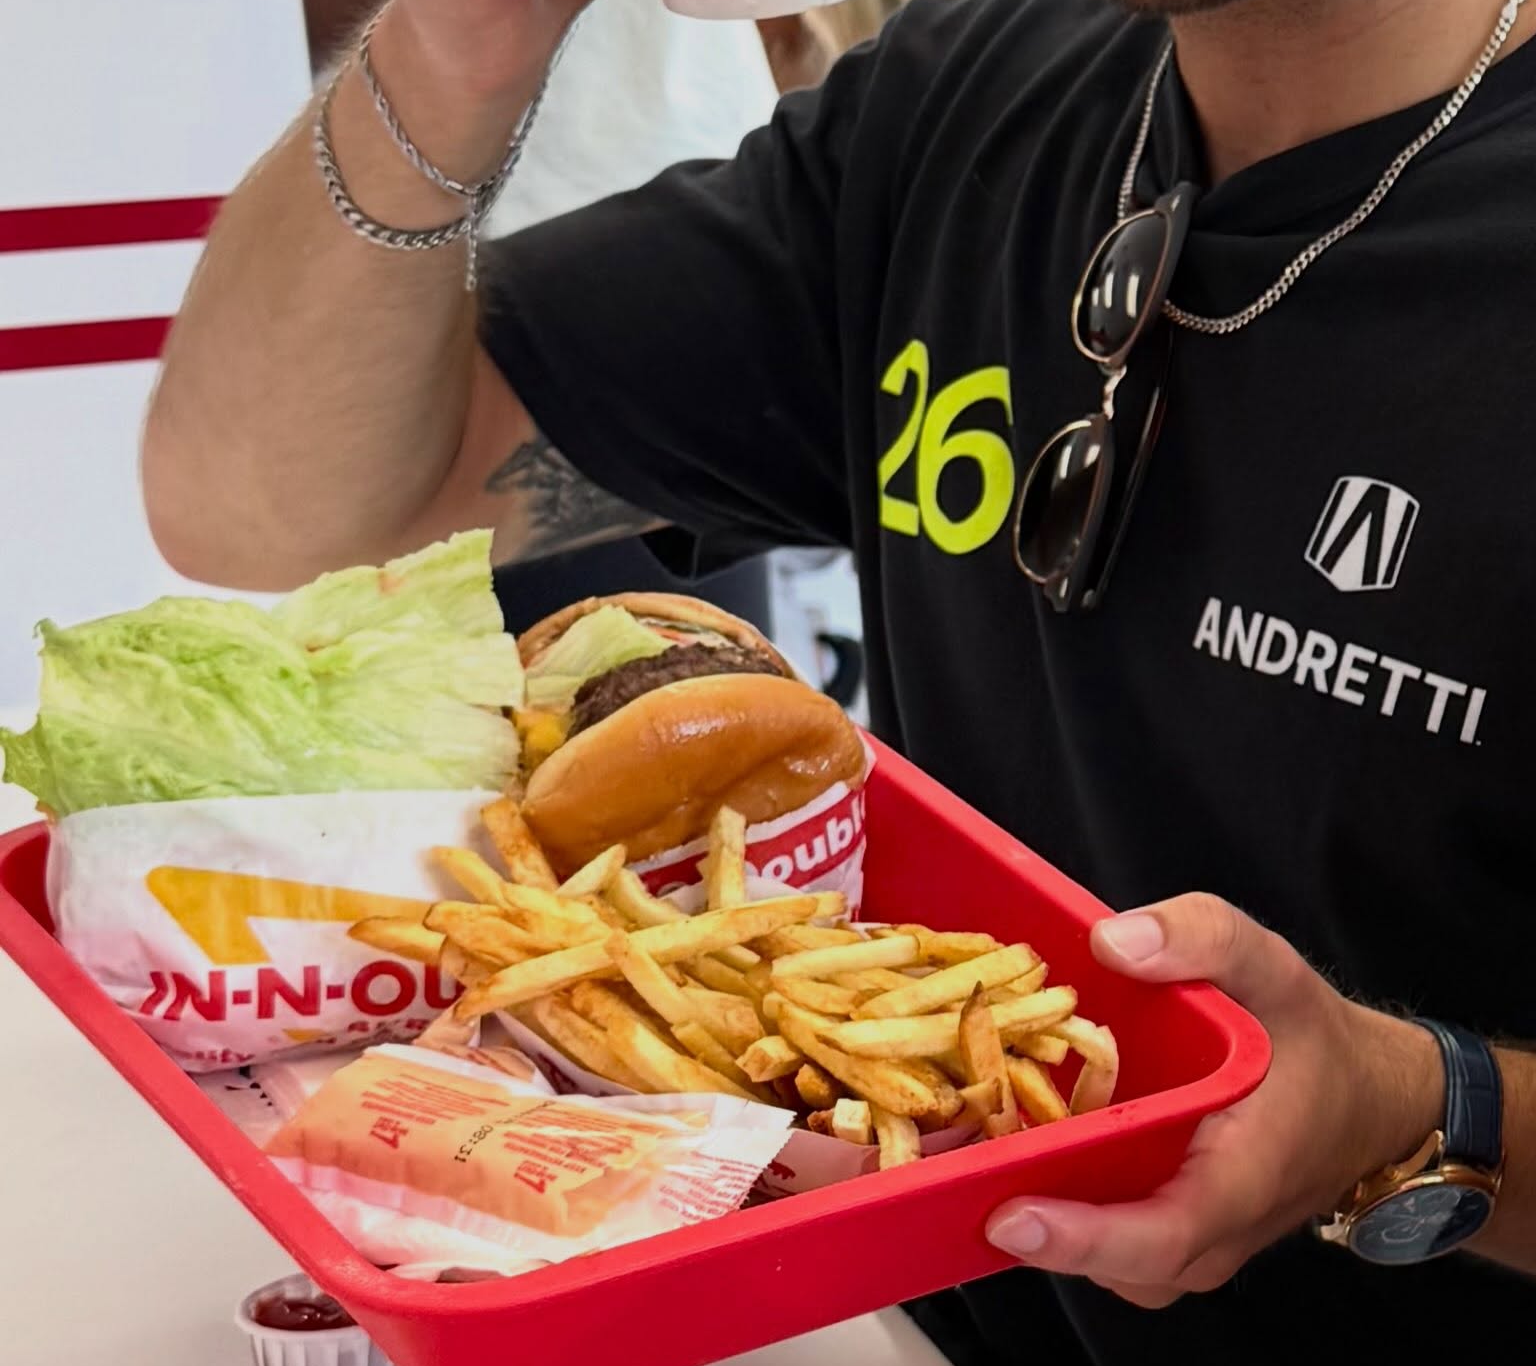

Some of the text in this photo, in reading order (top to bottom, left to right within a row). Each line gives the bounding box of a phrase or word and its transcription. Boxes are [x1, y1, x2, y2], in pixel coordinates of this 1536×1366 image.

[878, 339, 1015, 555] 26
[1193, 597, 1487, 745] ANDRETTI
[745, 790, 866, 884] oubl
